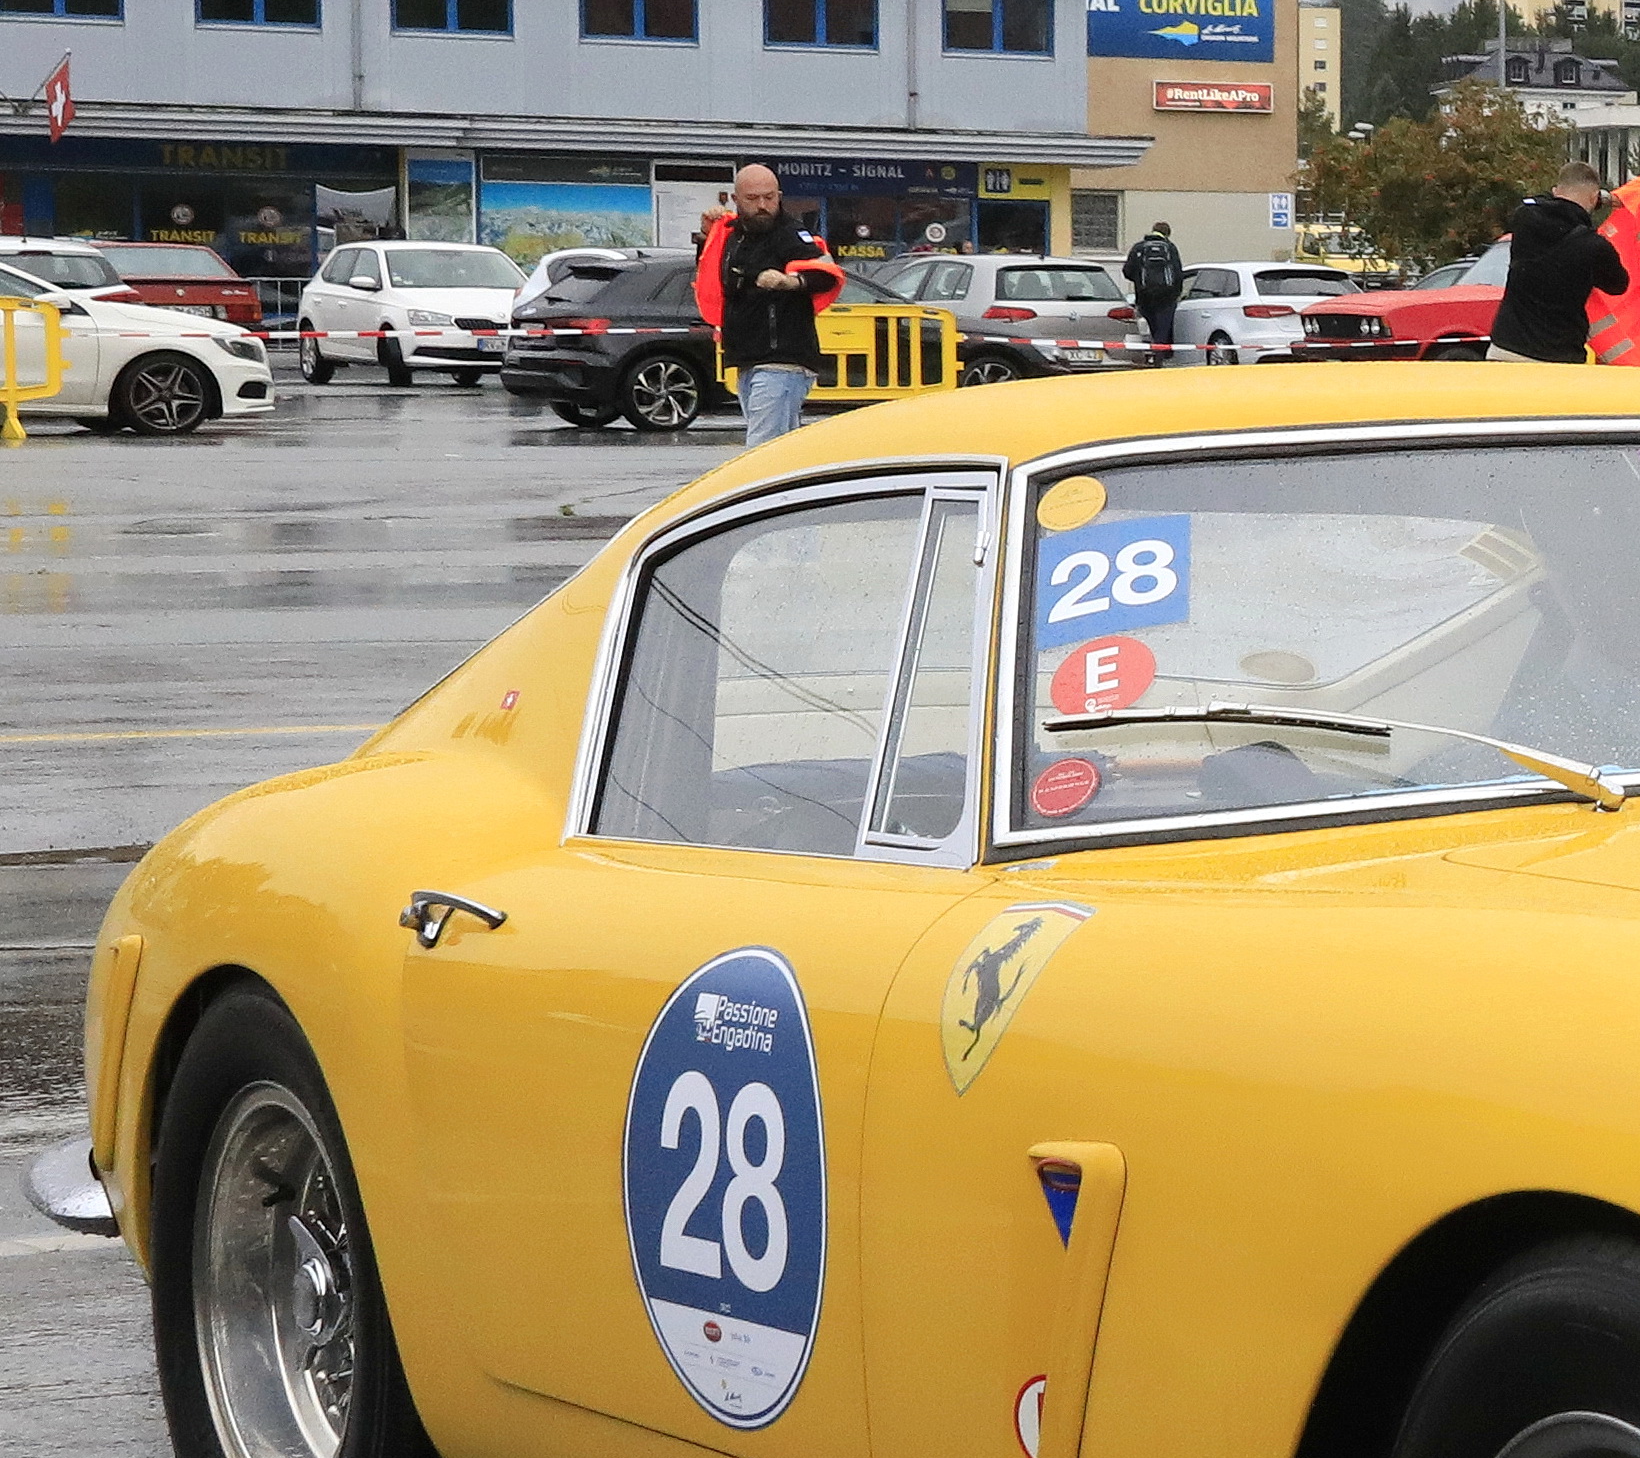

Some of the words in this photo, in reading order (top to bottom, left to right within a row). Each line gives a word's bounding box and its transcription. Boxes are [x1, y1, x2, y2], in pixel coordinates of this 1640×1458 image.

[1166, 88, 1259, 102] #RentLikeAPro
[162, 144, 287, 169] TRANSIT
[778, 163, 832, 177] MORITZ
[853, 163, 905, 178] SIGNAL
[150, 230, 216, 243] TRANSIT
[239, 231, 301, 244] TRANSIT
[837, 245, 887, 258] KASSA
[1047, 539, 1178, 624] 28
[1085, 646, 1121, 695] E
[716, 995, 778, 1028] Passione
[711, 1020, 773, 1052] Engadina
[660, 1070, 788, 1293] 28
